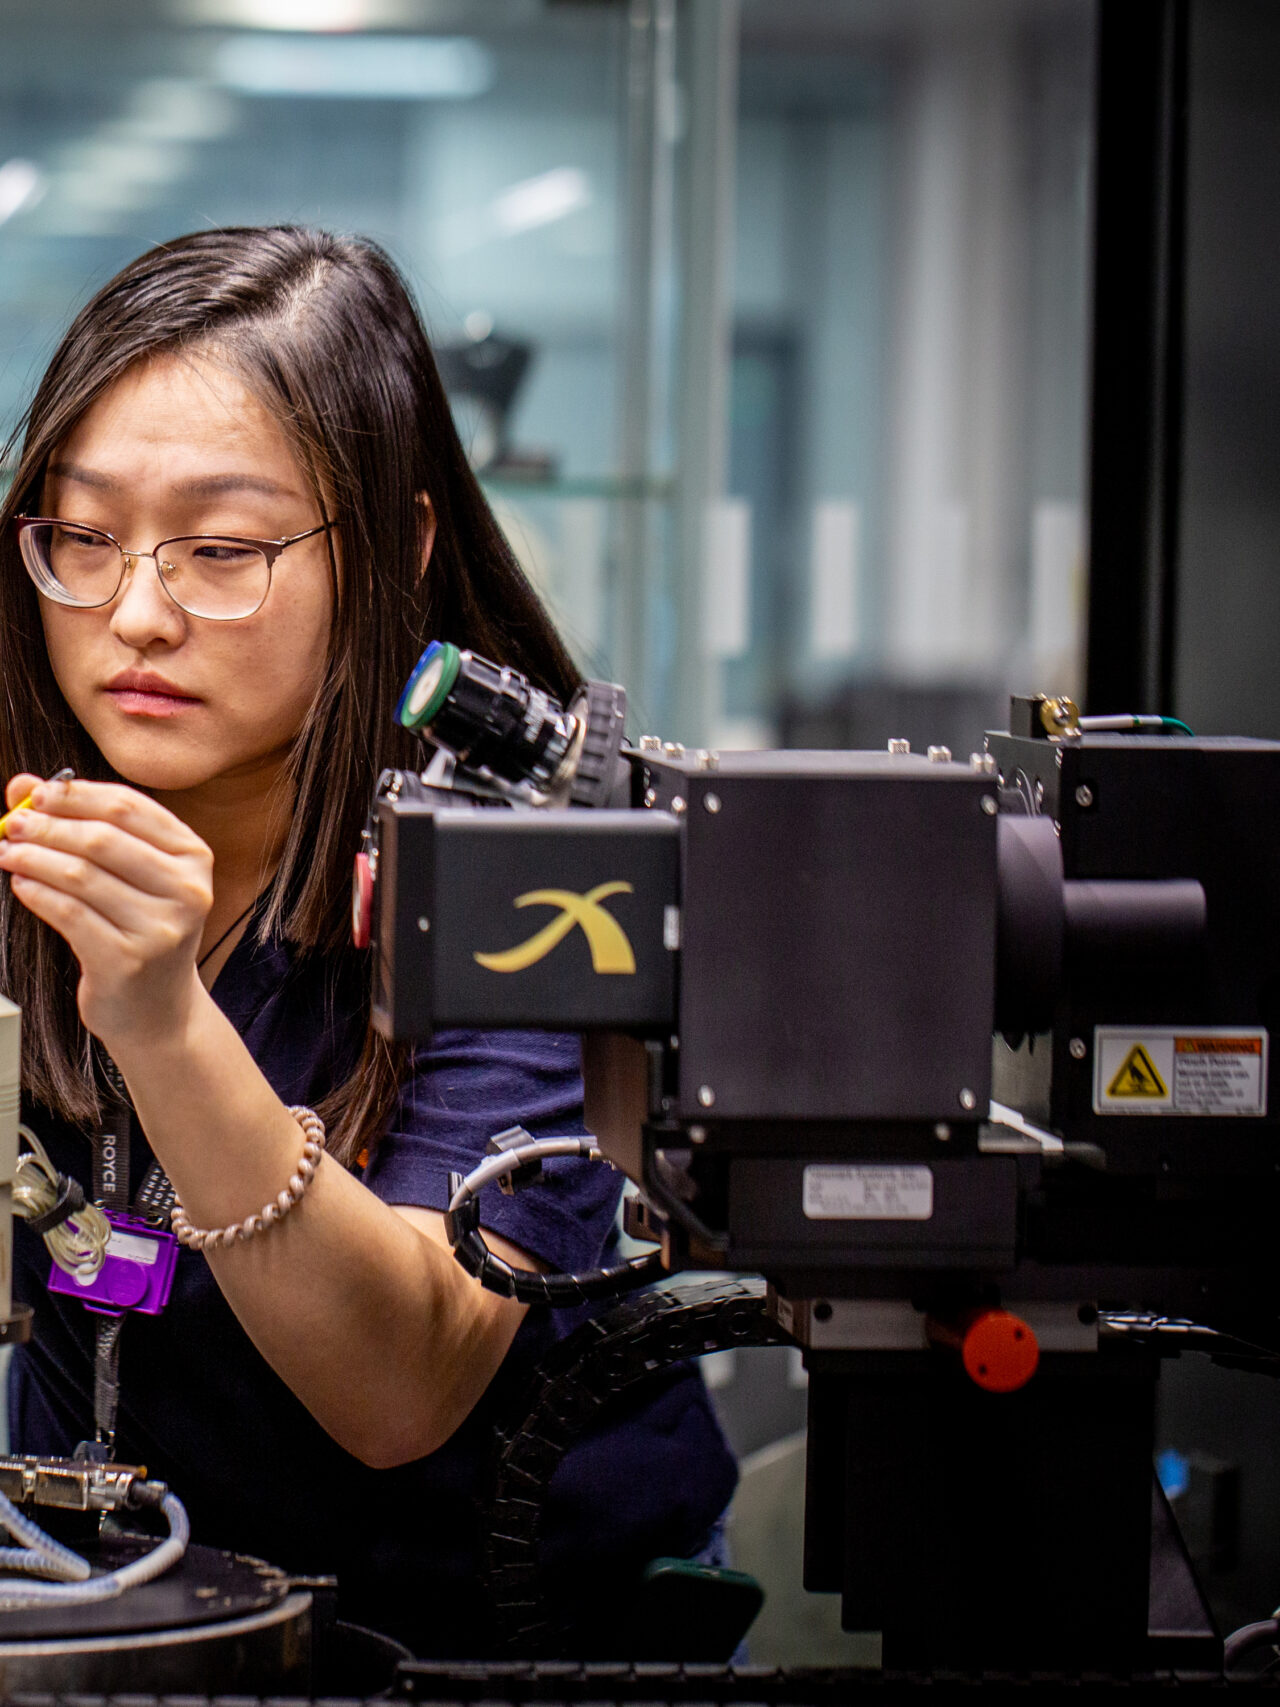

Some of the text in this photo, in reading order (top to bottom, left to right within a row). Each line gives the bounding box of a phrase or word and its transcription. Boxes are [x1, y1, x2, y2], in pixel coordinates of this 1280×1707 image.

[102, 1135, 116, 1192] ROYCE
[141, 1168, 160, 1202] HENRY
[151, 1177, 170, 1206] ROYC
